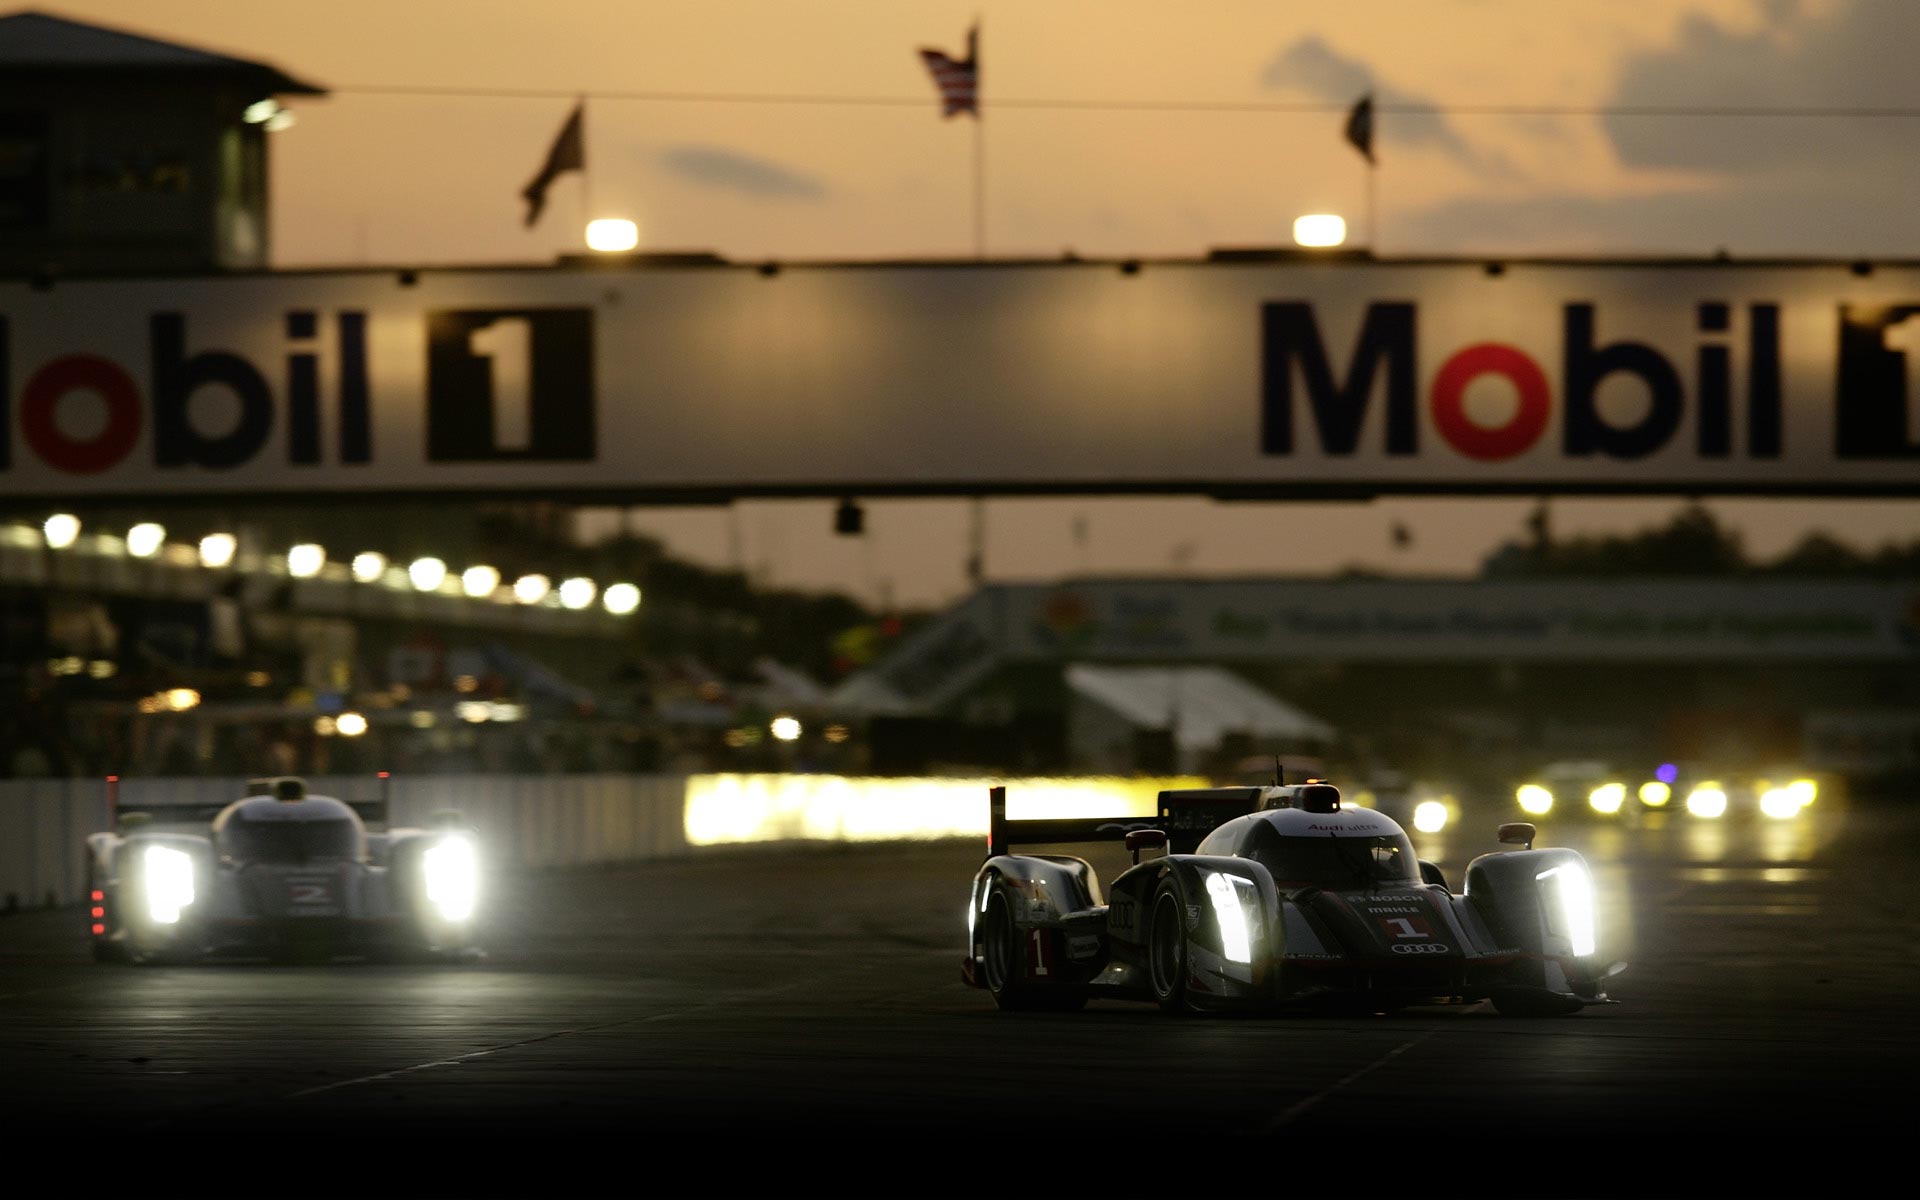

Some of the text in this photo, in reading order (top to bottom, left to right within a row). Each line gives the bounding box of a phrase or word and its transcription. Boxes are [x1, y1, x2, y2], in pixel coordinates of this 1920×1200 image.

[0, 311, 532, 475] obil 1
[1261, 302, 1782, 461] Mobil
[1032, 929, 1048, 976] 1
[1387, 917, 1430, 938] 1
